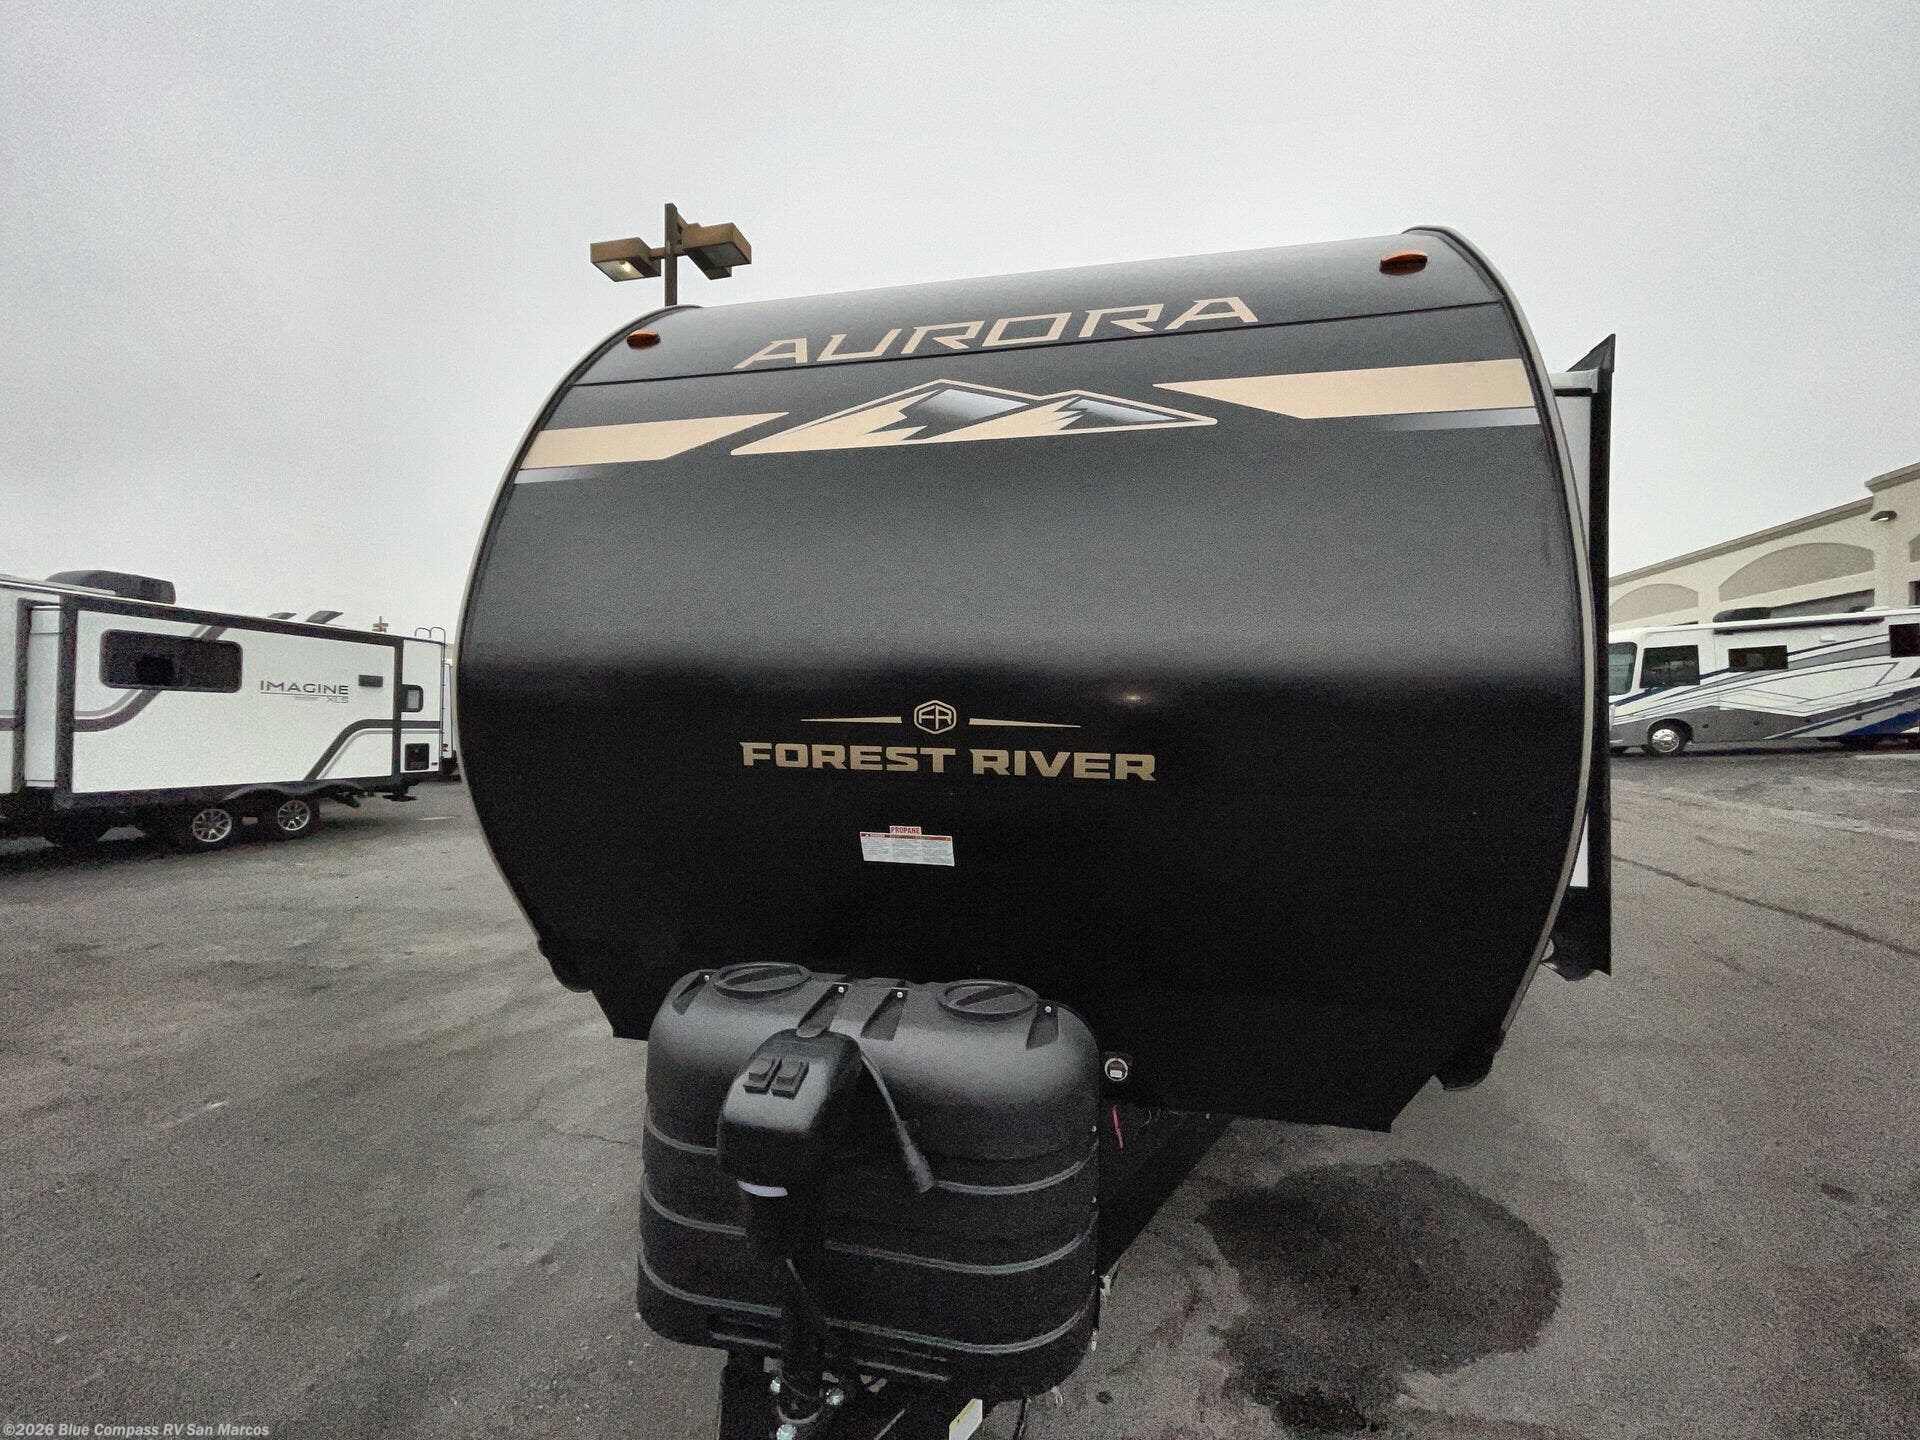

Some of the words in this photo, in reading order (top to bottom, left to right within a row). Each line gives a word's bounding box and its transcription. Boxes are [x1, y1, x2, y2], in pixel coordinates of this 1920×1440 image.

[734, 296, 1259, 369] AURORA
[260, 680, 349, 695] IMAGINE
[739, 741, 956, 773] FOREST
[969, 748, 1157, 782] RIVER
[890, 826, 921, 835] PROPANE
